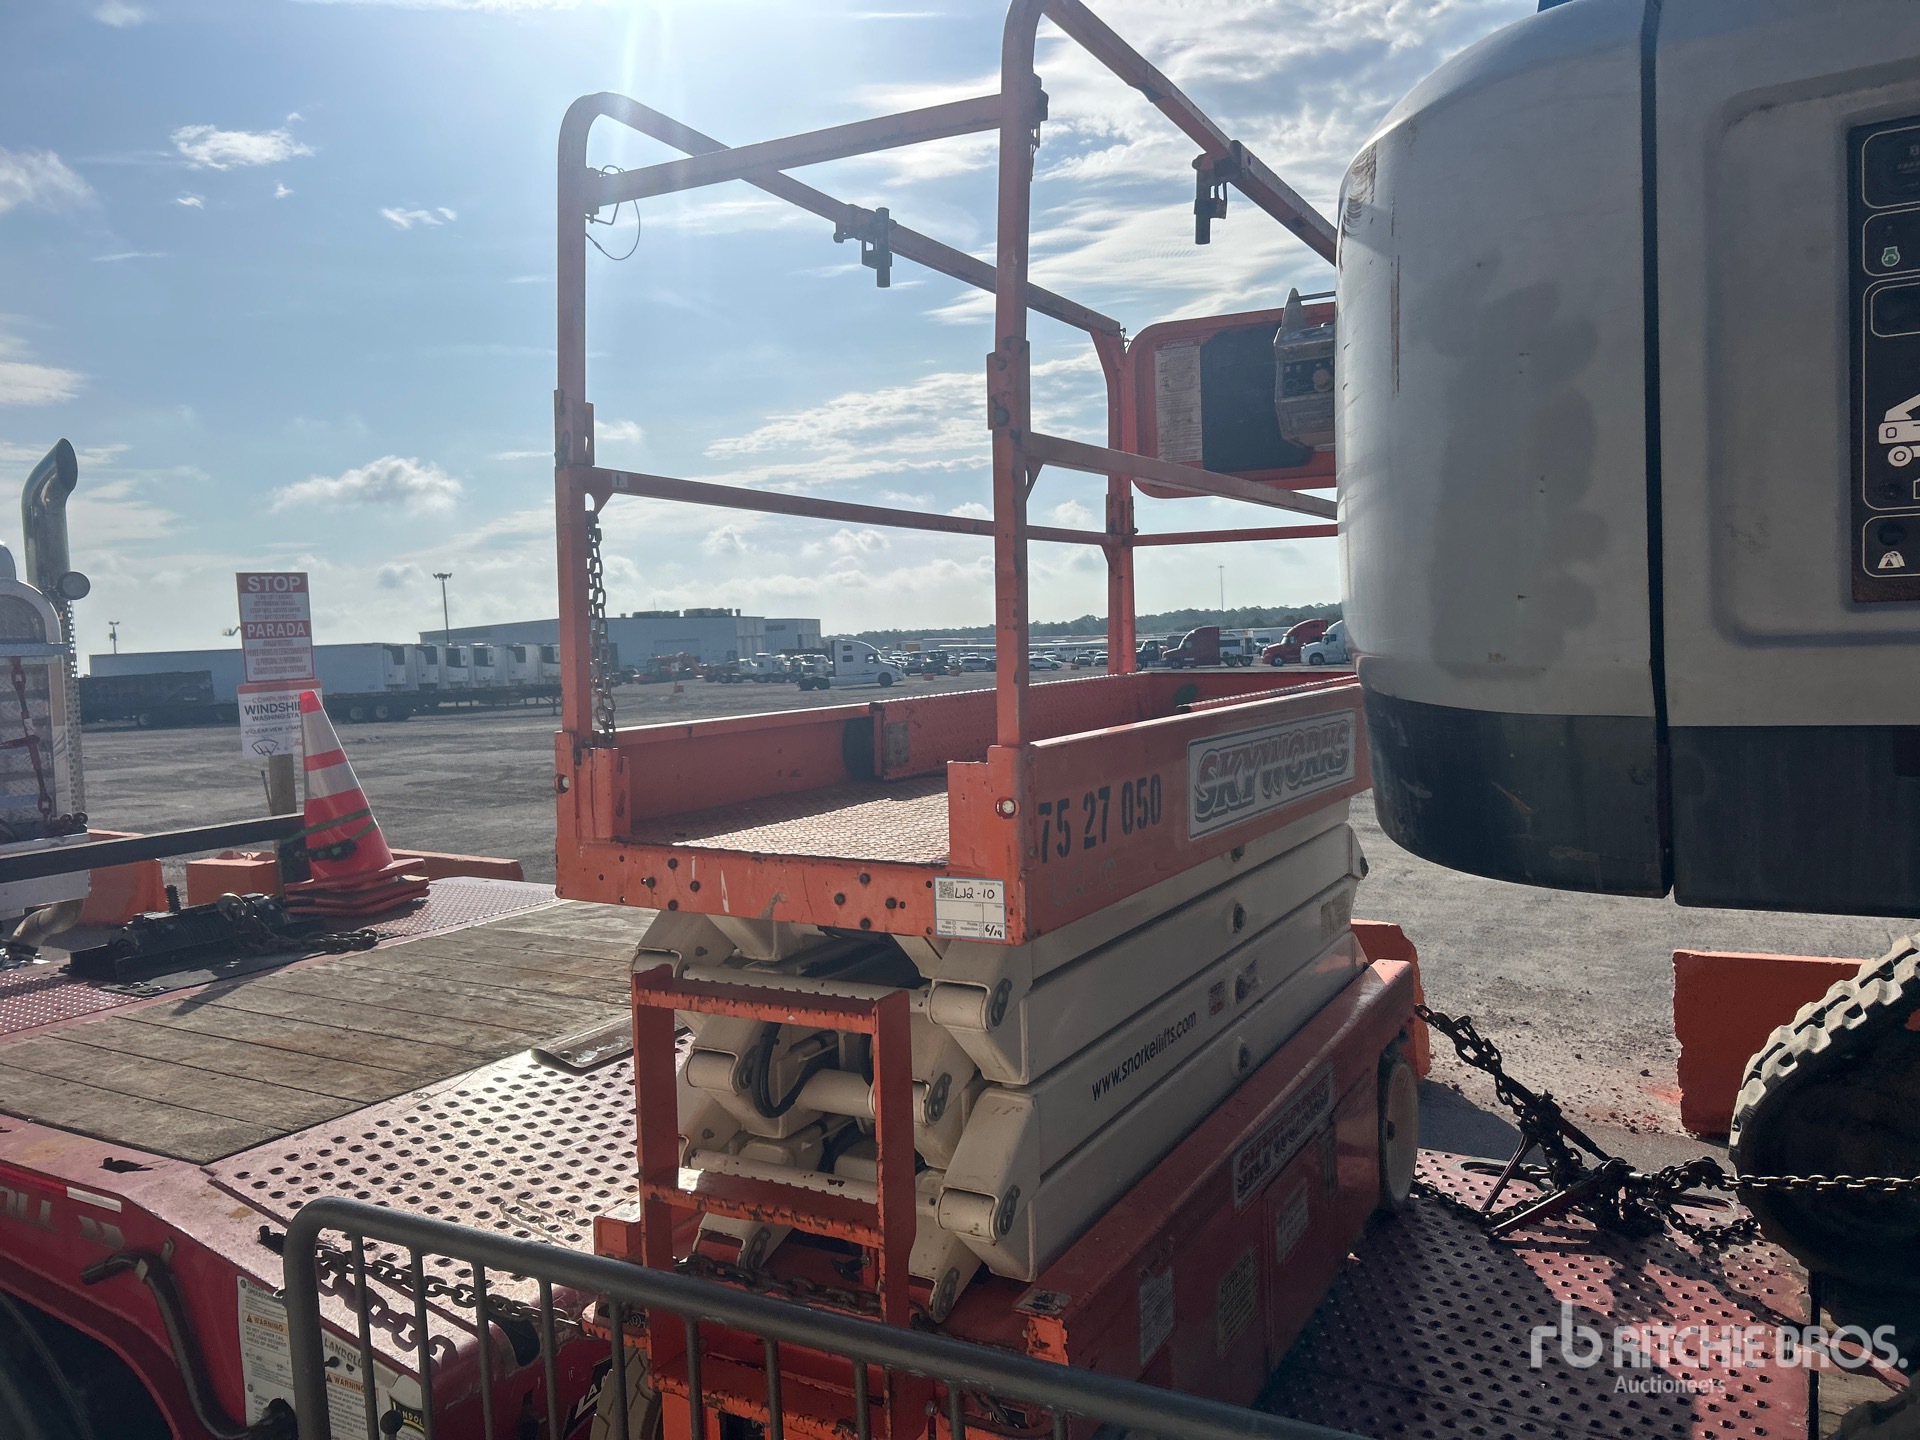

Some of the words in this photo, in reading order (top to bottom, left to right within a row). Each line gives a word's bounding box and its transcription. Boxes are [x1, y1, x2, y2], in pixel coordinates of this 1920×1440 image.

[247, 575, 301, 592] STOP
[247, 622, 306, 638] PARADA
[1193, 719, 1351, 823] SKYWORKS
[1038, 797, 1072, 864] 75
[1083, 785, 1111, 850] 27
[1121, 773, 1162, 836] 050
[253, 1315, 284, 1332] WARNING
[324, 1337, 363, 1369] LANDOLL
